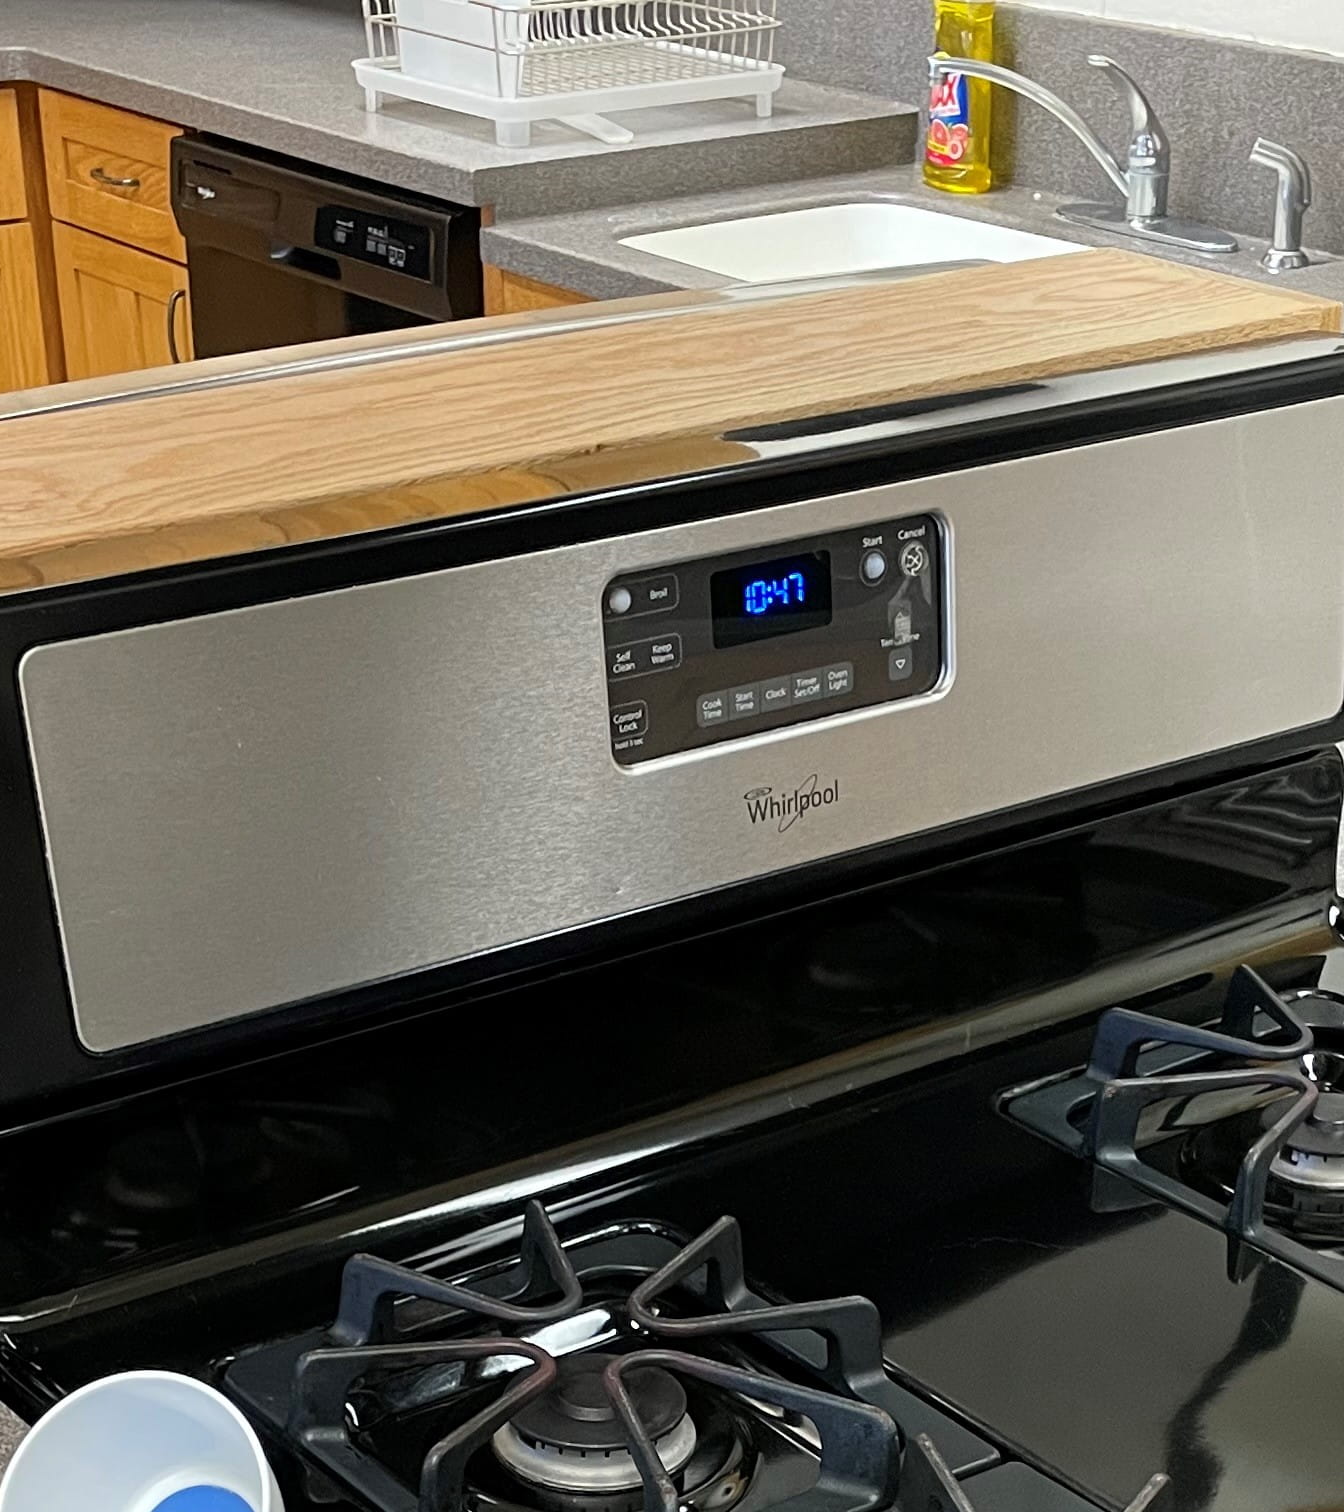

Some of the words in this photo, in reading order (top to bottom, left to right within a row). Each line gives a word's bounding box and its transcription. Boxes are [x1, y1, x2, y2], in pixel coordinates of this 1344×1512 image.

[897, 525, 926, 540] Cancel
[862, 535, 883, 548] Start
[649, 587, 669, 601] Broil
[745, 572, 805, 614] 10:47
[616, 650, 631, 663] Self
[612, 662, 636, 674] Clean
[827, 669, 848, 681] Oven
[796, 677, 817, 689] Timer
[828, 678, 848, 690] Light
[735, 691, 753, 702] Start
[765, 688, 787, 700] Clock
[702, 698, 722, 710] Cook
[735, 701, 754, 712] Time
[613, 709, 642, 725] Control
[703, 709, 722, 720] Time
[619, 720, 638, 733] Lock
[746, 777, 839, 825] Whirlpool
